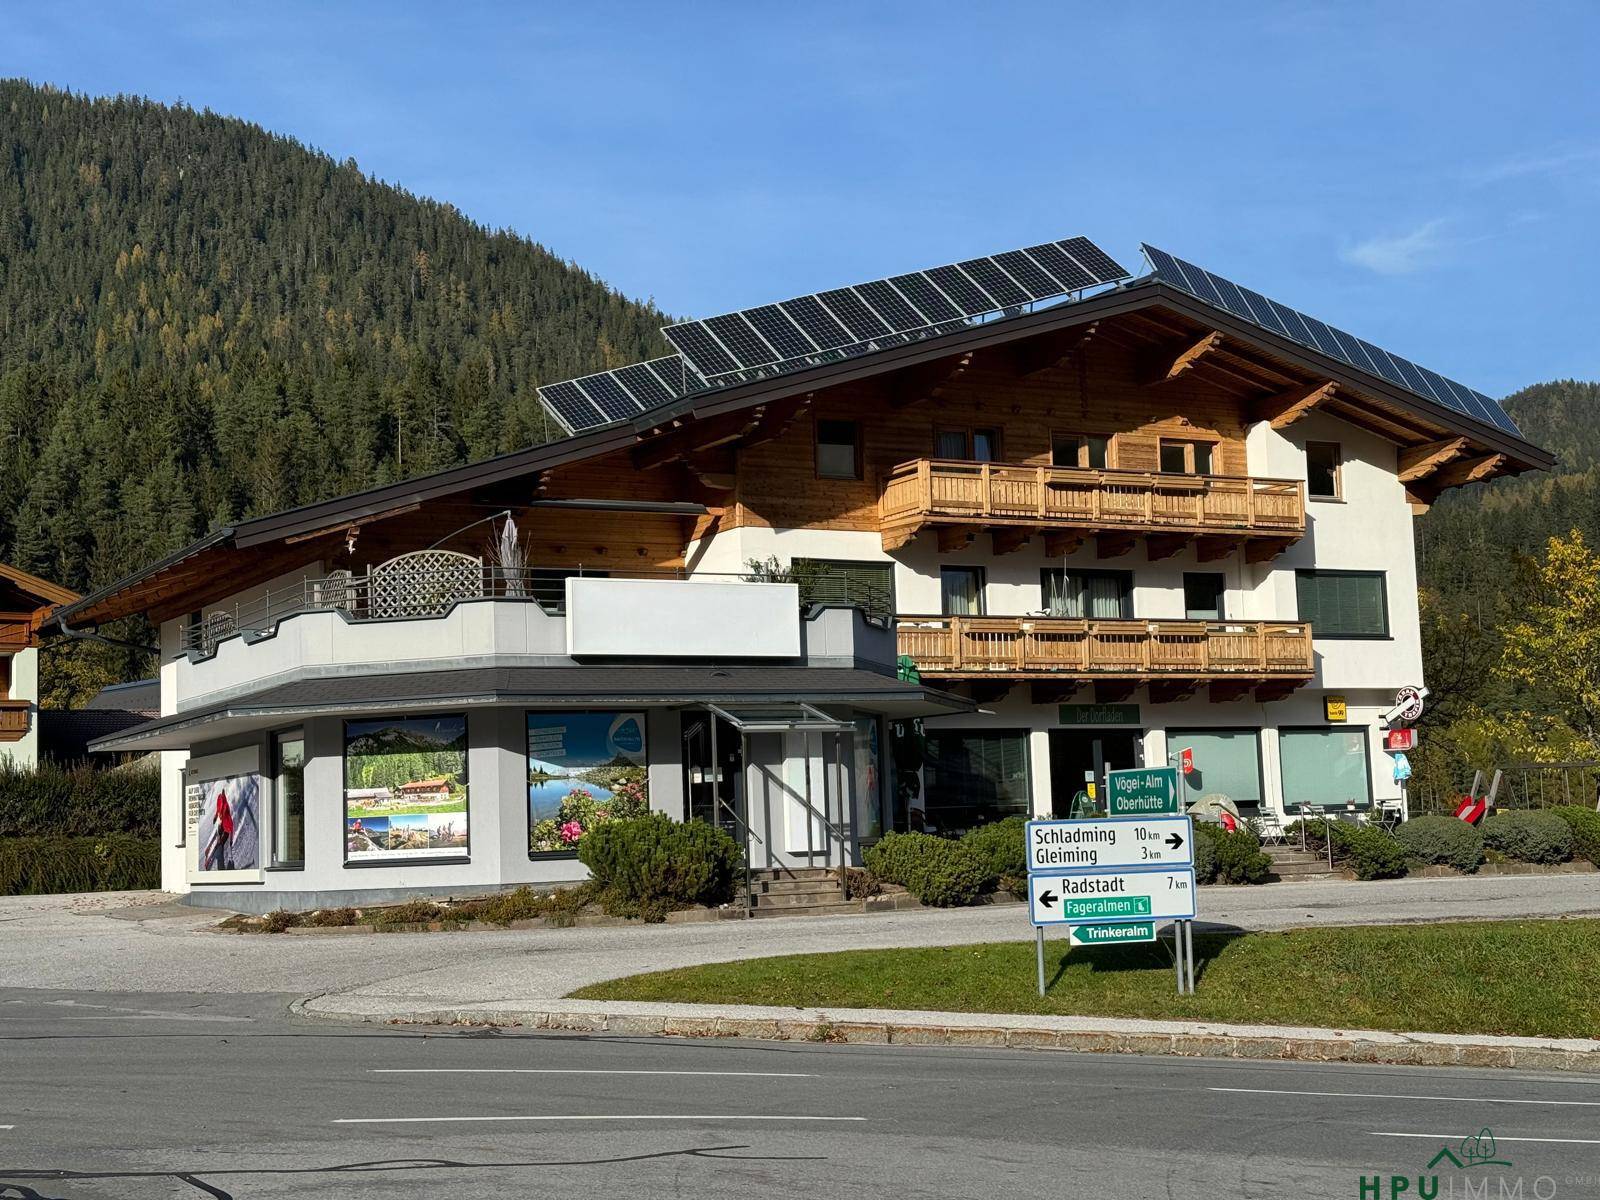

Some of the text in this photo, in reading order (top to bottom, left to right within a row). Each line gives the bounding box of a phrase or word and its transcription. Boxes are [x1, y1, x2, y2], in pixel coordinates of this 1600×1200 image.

[1116, 796, 1163, 811] Oberhütte
[1035, 826, 1160, 845] Schladming 10 km
[1036, 846, 1161, 865] Gleiming 3 km
[1062, 876, 1187, 894] Radstadt 7 km
[1066, 900, 1131, 916] Fageralmen
[1086, 926, 1149, 940] Trinkeralm
